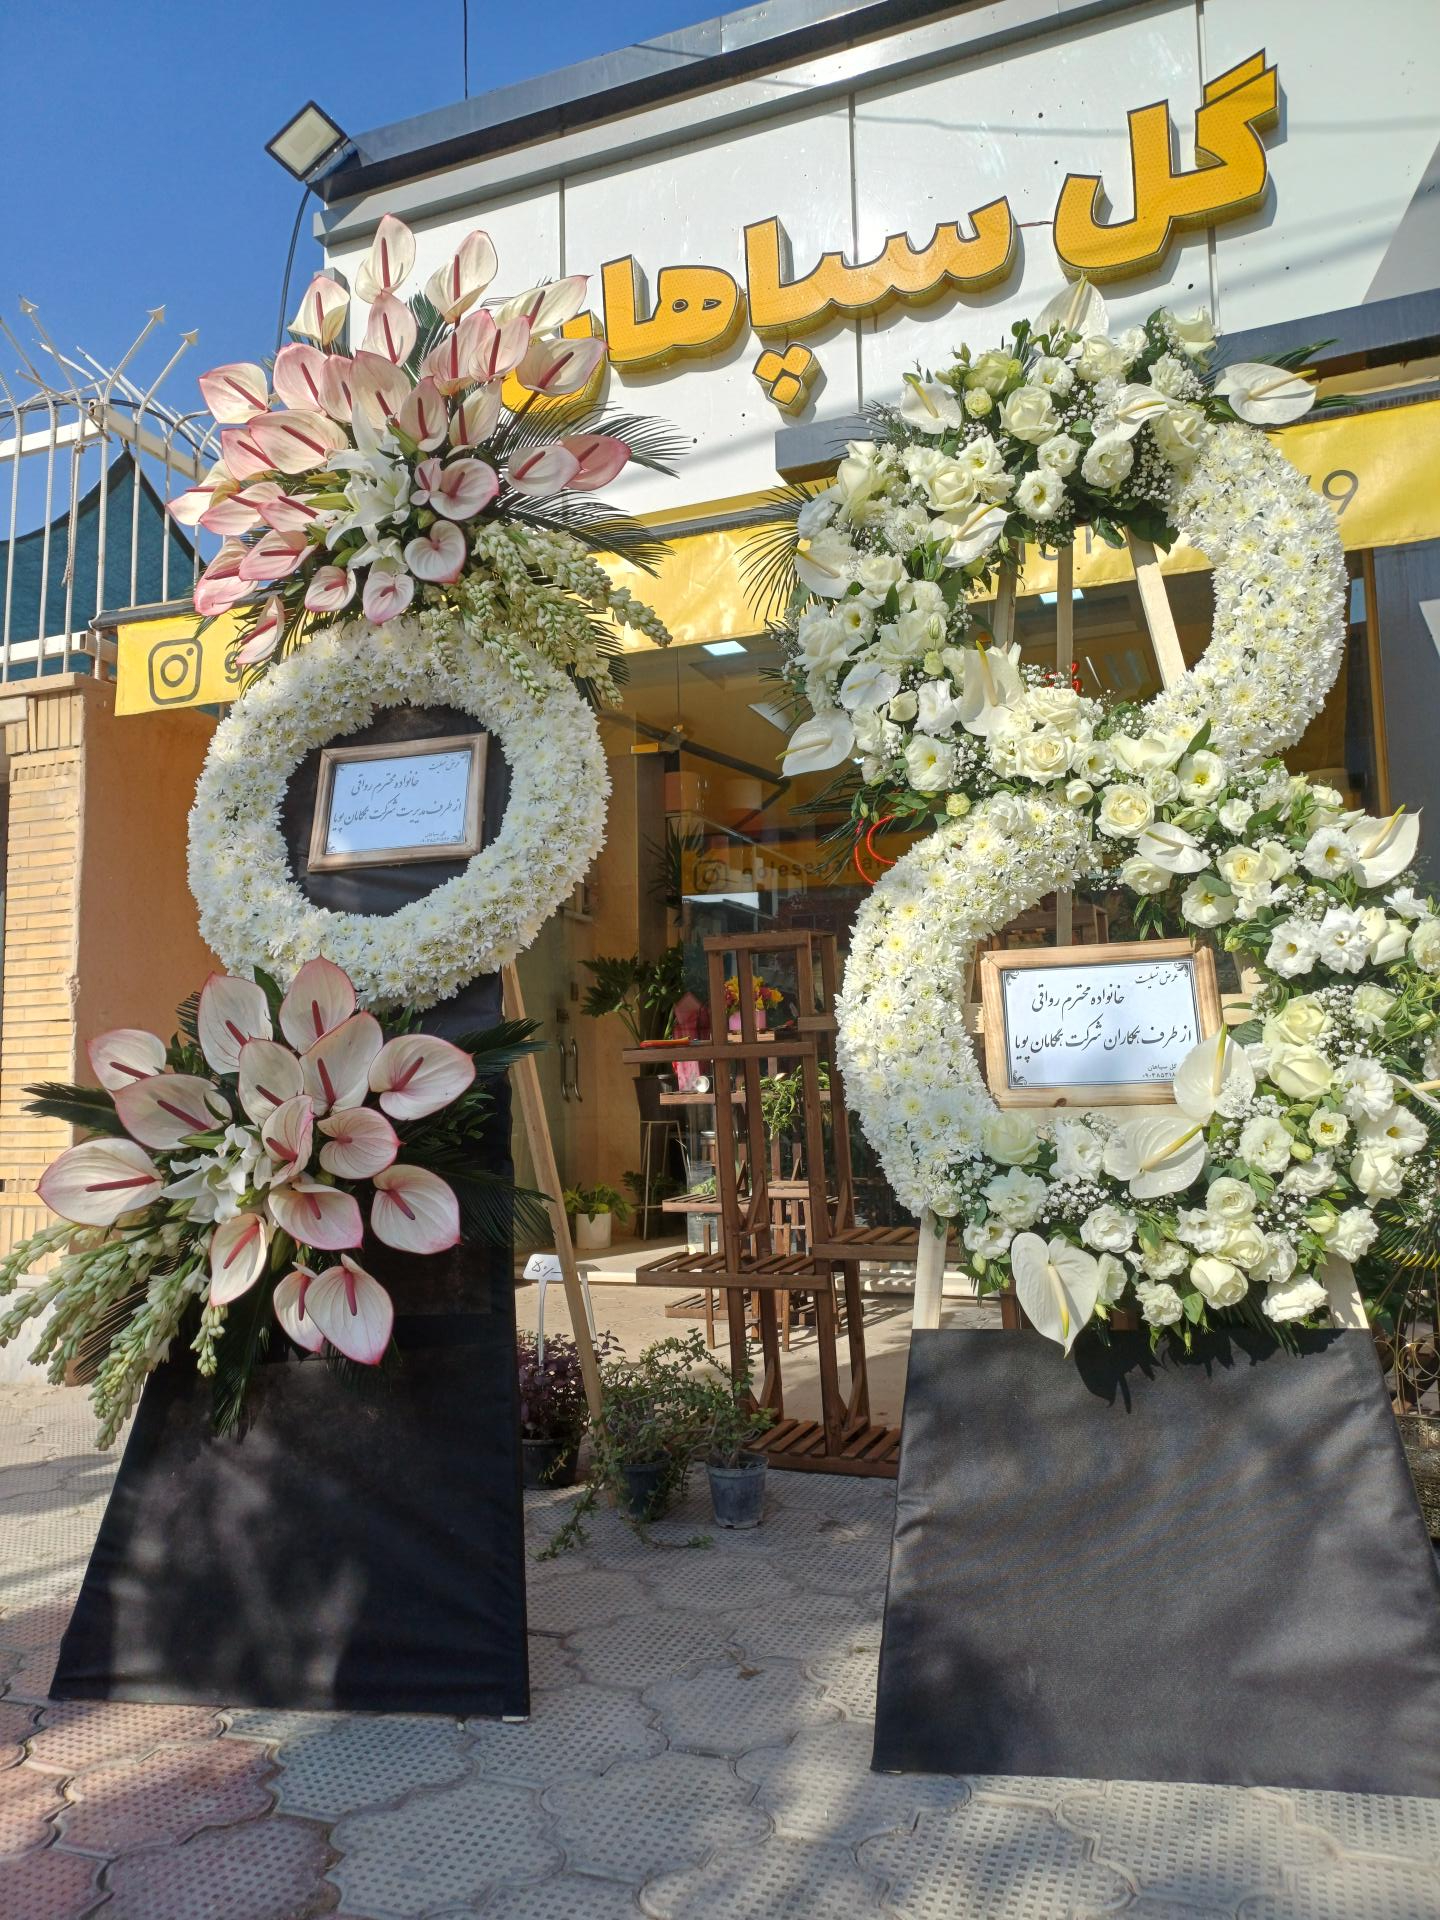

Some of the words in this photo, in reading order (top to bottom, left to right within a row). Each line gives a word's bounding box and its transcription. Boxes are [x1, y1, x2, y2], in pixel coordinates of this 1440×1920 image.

[1053, 47, 1280, 283] گل
[371, 772, 397, 801] محترم
[394, 770, 420, 789] خانواده
[369, 792, 401, 822] شرکت
[426, 798, 453, 817] طرف
[452, 798, 462, 812] از
[1134, 966, 1159, 989] تسلیت
[1159, 970, 1178, 986] عرض
[1031, 983, 1061, 1013] رواقی
[1061, 983, 1091, 1021] محترم
[1090, 983, 1125, 1006] خانواده
[1065, 1013, 1104, 1052] شرکت
[1103, 1024, 1141, 1052] همکاران
[1141, 1025, 1178, 1049] طرف
[1179, 1025, 1192, 1043] از
[1014, 1034, 1031, 1064] پویا
